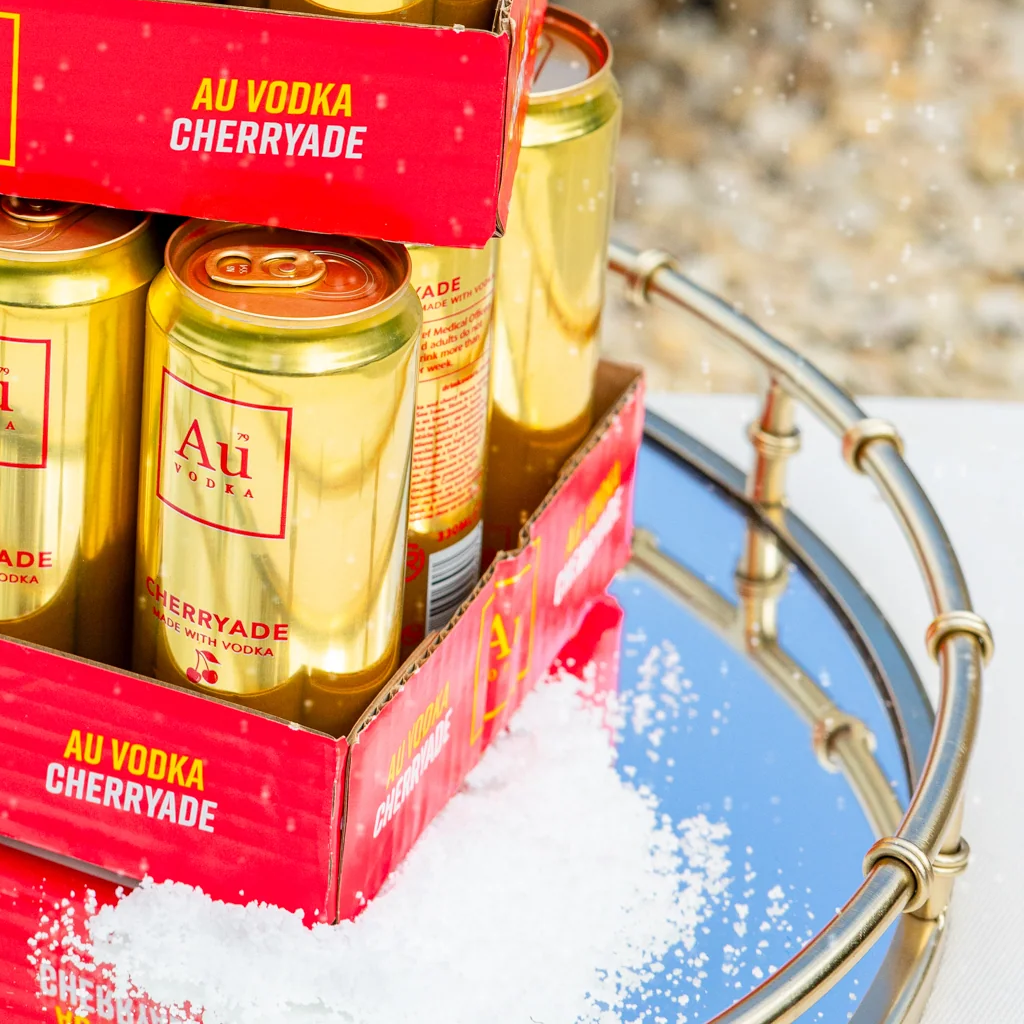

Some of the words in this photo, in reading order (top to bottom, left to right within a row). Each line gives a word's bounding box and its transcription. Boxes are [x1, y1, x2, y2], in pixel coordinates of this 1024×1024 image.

[191, 77, 241, 112] AU
[247, 78, 353, 118] VODKA
[168, 116, 368, 160] CHERRYADE
[174, 418, 253, 480] Au
[236, 432, 250, 442] 79
[174, 462, 254, 500] VODKA
[145, 575, 290, 642] CHERRYADE
[152, 606, 182, 634] MADE
[184, 627, 218, 649] WITH
[221, 641, 275, 658] VODKA
[63, 728, 105, 767] AU
[111, 739, 205, 792] VODKA
[386, 739, 406, 791] AU
[408, 680, 450, 759] VODKA
[45, 761, 219, 834] CHERRYADE
[373, 706, 454, 839] CHERRYADE
